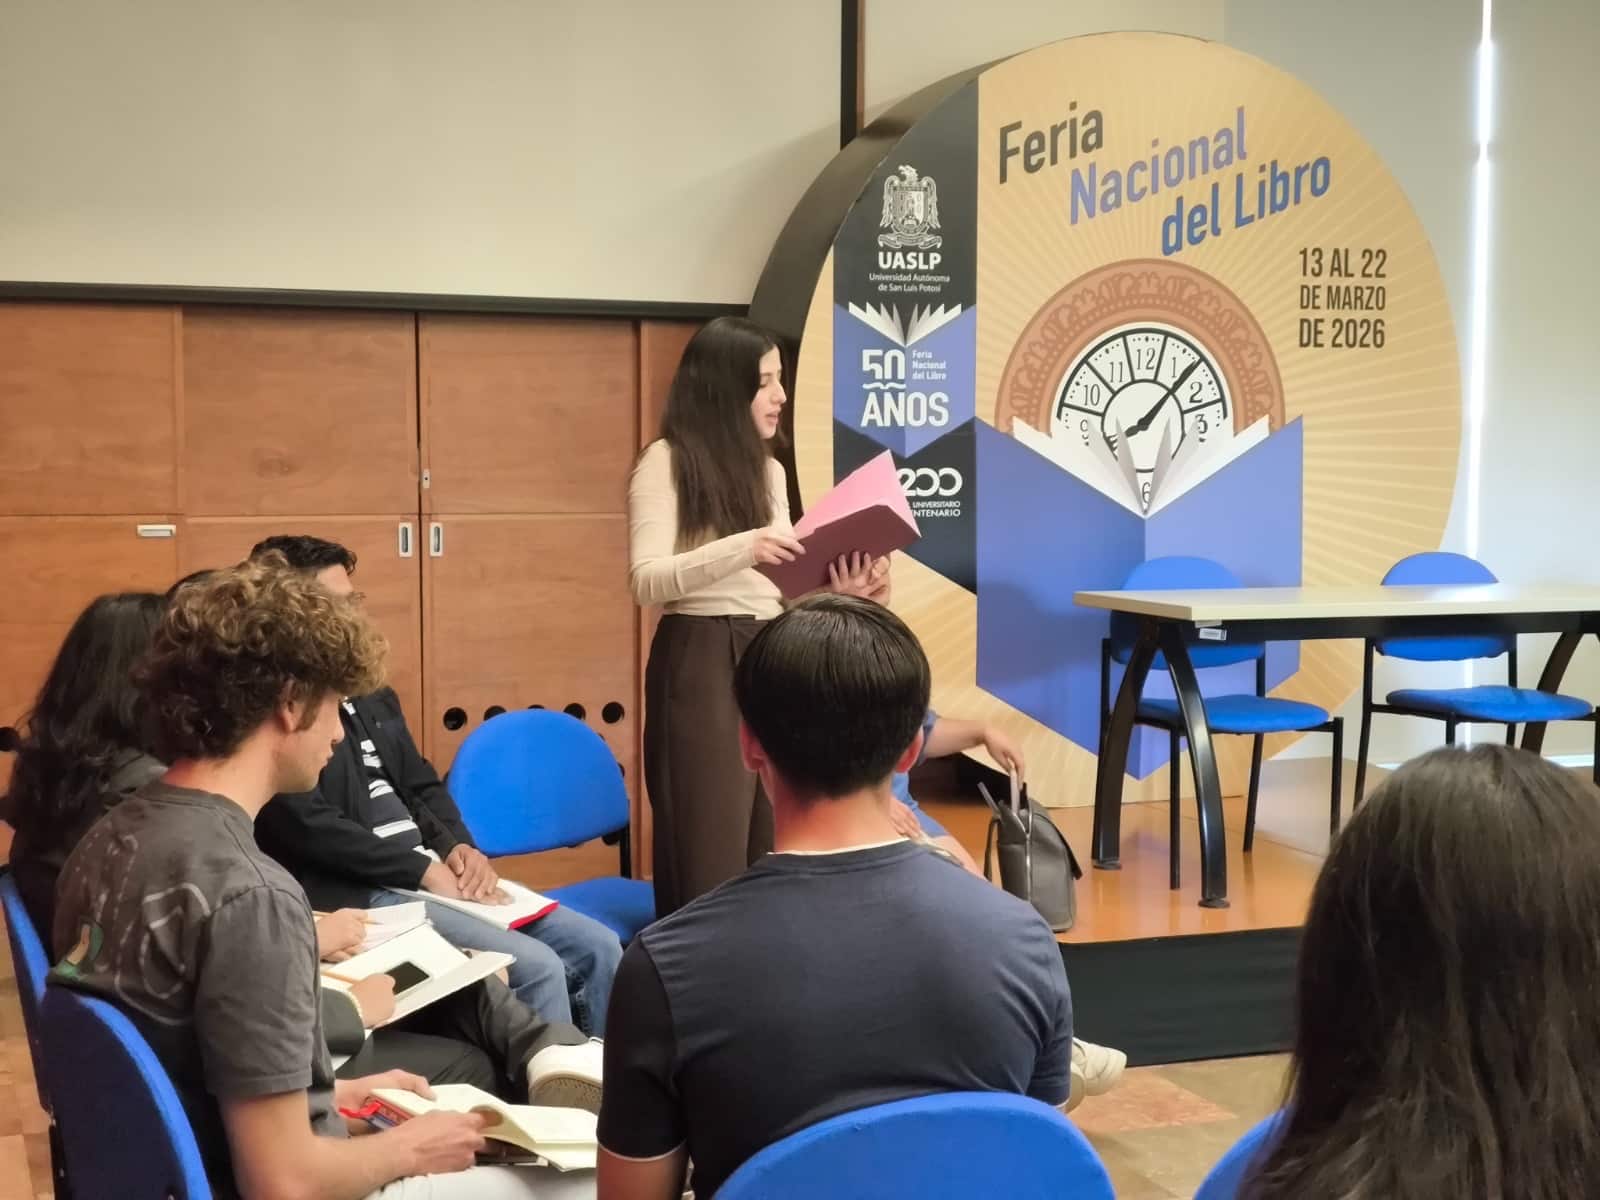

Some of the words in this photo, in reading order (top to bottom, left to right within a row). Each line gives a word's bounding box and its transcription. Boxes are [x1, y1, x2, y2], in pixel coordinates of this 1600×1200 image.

[999, 101, 1104, 184] Feria
[1069, 105, 1248, 225] Nacional
[1161, 181, 1221, 256] del
[1234, 155, 1331, 228] Libro
[878, 251, 942, 270] UASLP
[1299, 247, 1323, 277] 13
[1329, 247, 1354, 278] AL
[1361, 248, 1387, 278] 22
[869, 272, 912, 281] Universidad
[913, 273, 950, 282] Autónoma
[878, 283, 888, 291] de
[889, 283, 902, 291] San
[904, 283, 918, 292] Luis
[1300, 285, 1321, 310] DE
[1326, 285, 1386, 311] MARZO
[1299, 318, 1324, 348] DE
[1331, 318, 1385, 348] 2026
[862, 349, 906, 379] 50
[912, 350, 933, 358] Feria
[912, 360, 946, 369] Nacional
[1136, 347, 1155, 370] 12
[912, 371, 925, 380] del
[926, 371, 947, 380] Libro
[1110, 361, 1124, 383] 11
[1171, 357, 1178, 378] 1
[1084, 383, 1100, 406] 10
[1189, 381, 1203, 404] 2
[861, 382, 949, 427] AÑOS
[912, 509, 961, 517] NTENARIO
